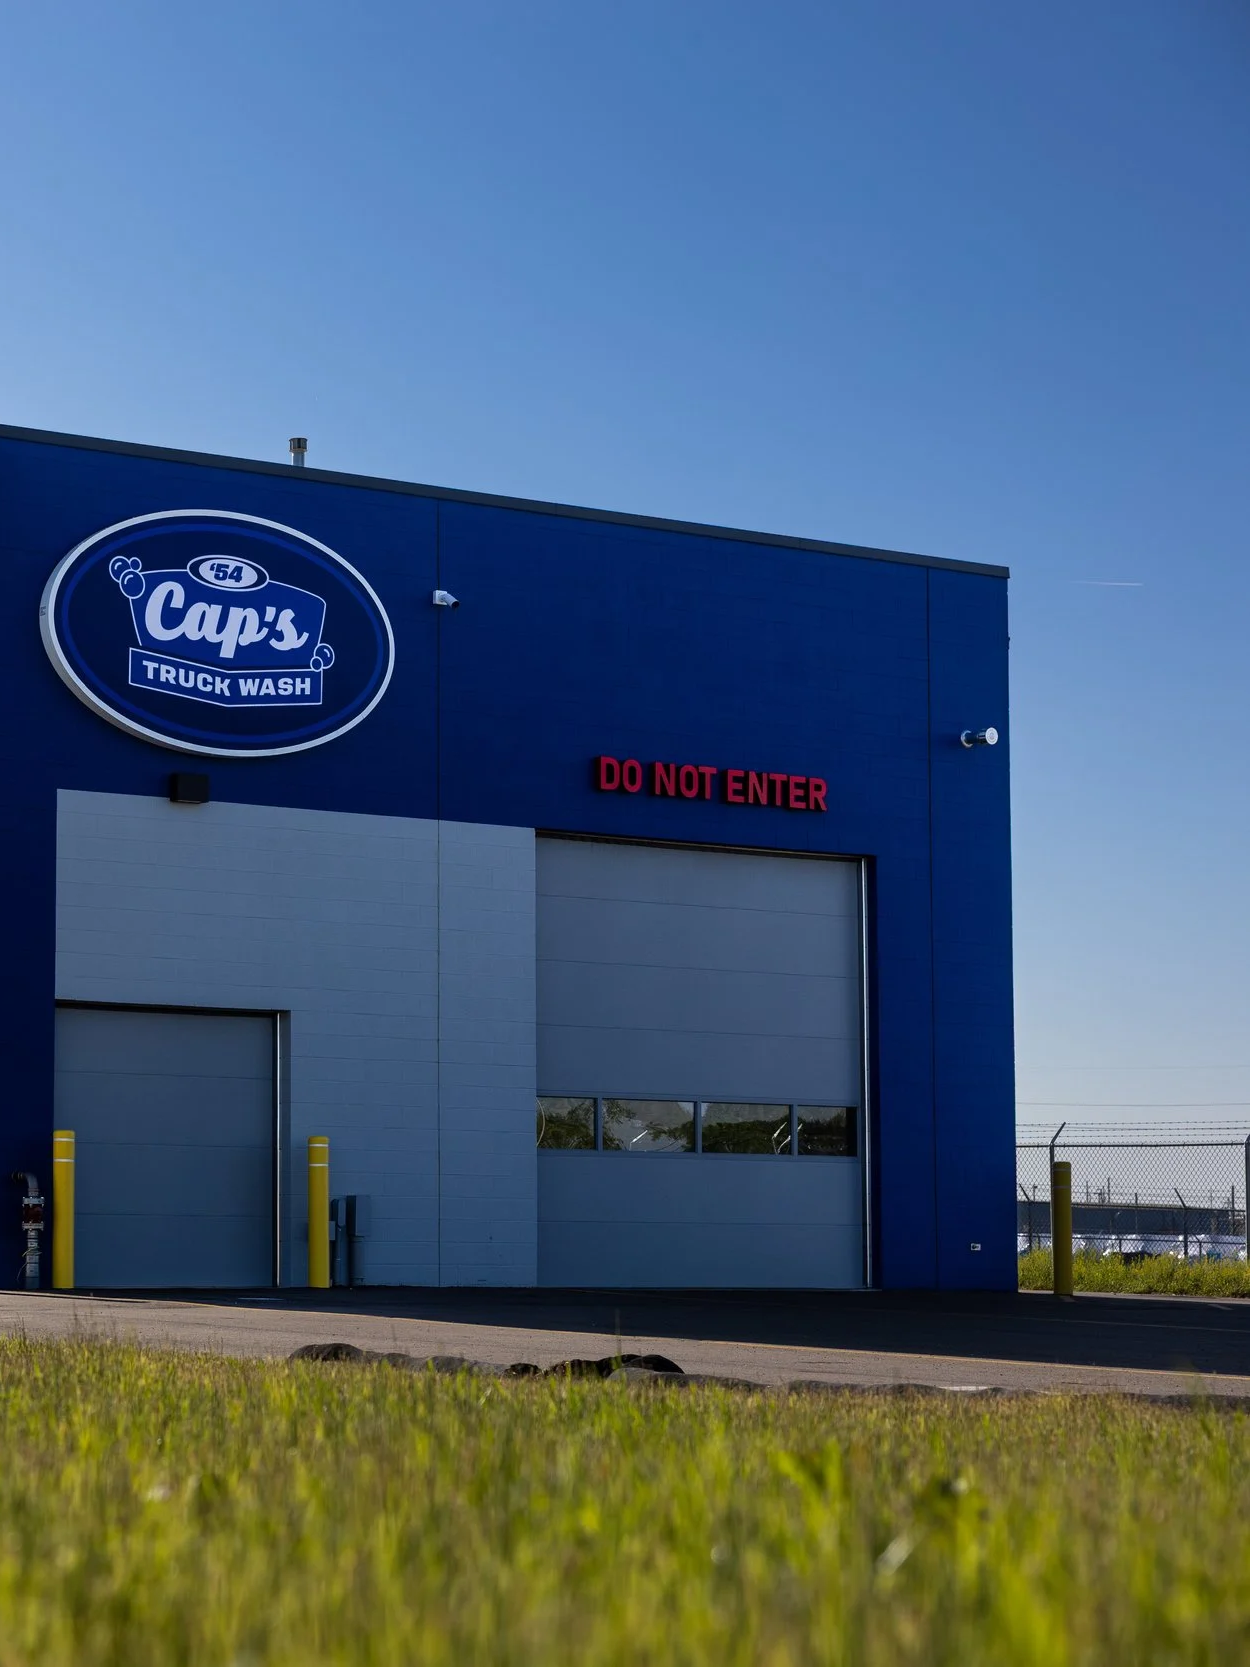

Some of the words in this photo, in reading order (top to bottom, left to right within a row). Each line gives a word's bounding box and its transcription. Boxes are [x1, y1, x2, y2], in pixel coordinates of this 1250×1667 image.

[145, 581, 309, 658] Cap's
[142, 660, 231, 697] TRUCK
[239, 678, 311, 696] WASH
[599, 756, 643, 793] DO
[654, 762, 718, 800] NOT
[726, 769, 827, 811] ENTER
